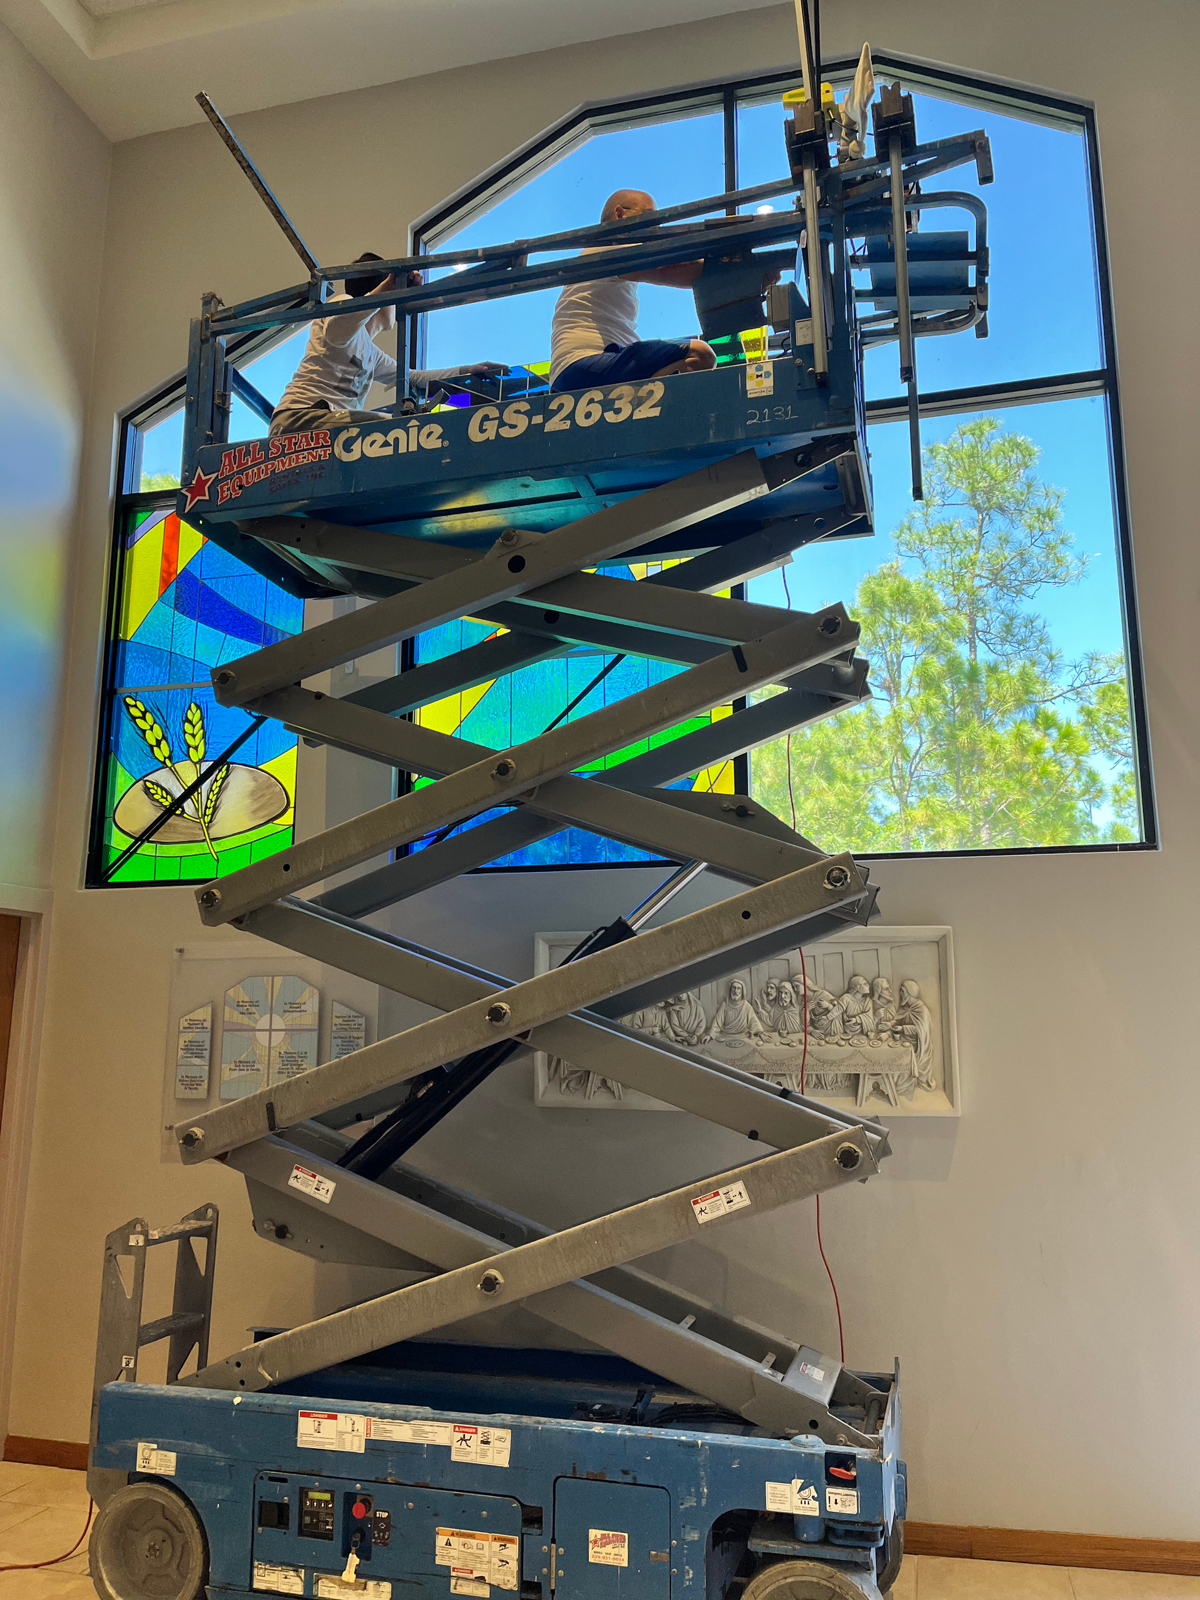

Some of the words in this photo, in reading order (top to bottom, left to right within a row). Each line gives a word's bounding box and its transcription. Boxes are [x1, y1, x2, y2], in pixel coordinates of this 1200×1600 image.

[334, 419, 443, 462] Genie
[468, 381, 665, 442] GS-2632
[746, 405, 799, 425] 2131
[217, 447, 332, 505] EQUIPMENT
[218, 441, 265, 479] ALL
[269, 430, 331, 458] STAR
